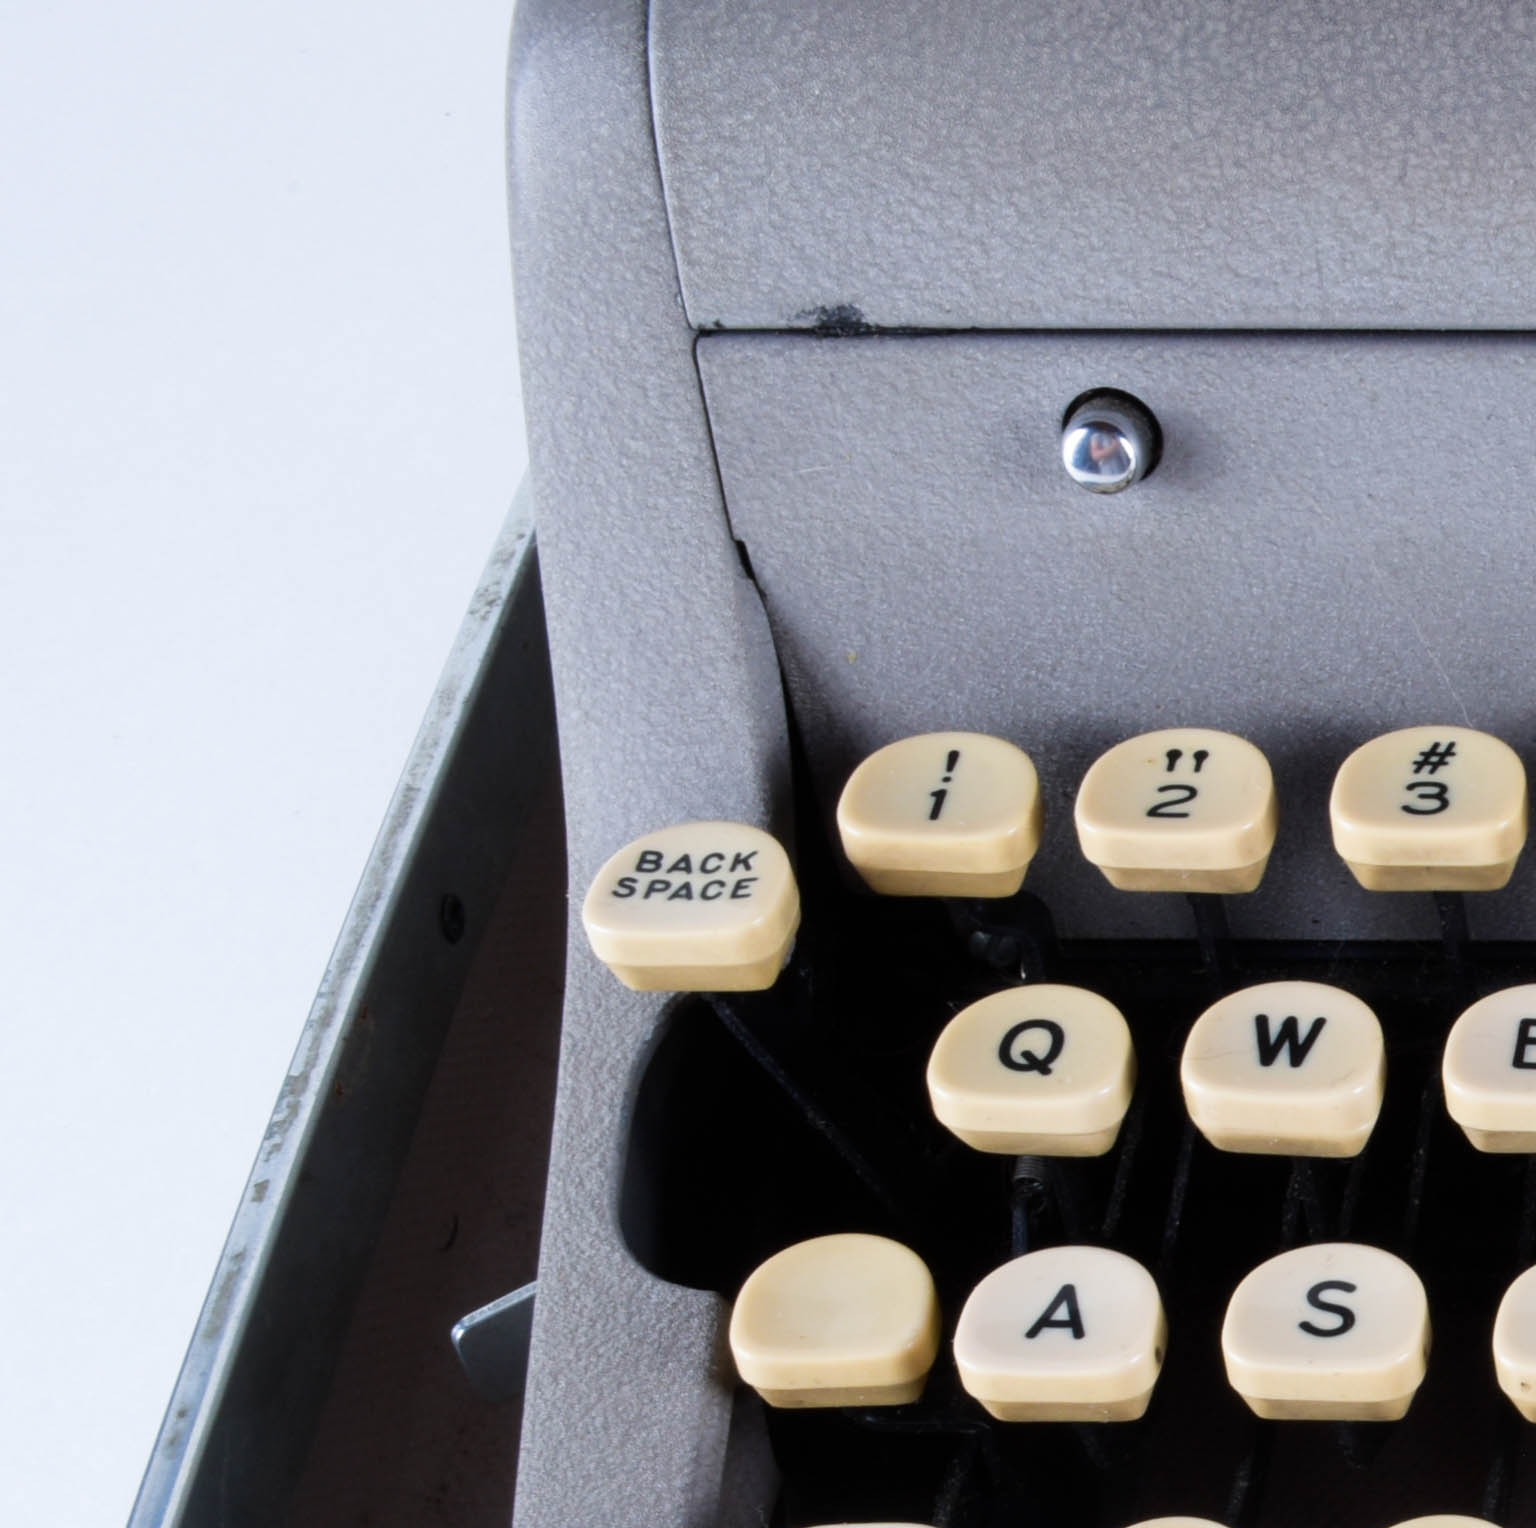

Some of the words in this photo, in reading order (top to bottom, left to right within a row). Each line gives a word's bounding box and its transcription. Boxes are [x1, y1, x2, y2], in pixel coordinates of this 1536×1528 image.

[939, 747, 962, 786] !
[1410, 739, 1459, 778] #
[926, 786, 950, 823] 1
[1143, 781, 1201, 821] 2
[1398, 778, 1452, 818] 3
[633, 848, 760, 877] BACK
[609, 874, 760, 903] SPACE
[995, 1016, 1067, 1079] Q
[1252, 1011, 1329, 1071] W
[1022, 1281, 1088, 1342] A
[1295, 1278, 1359, 1341] S
